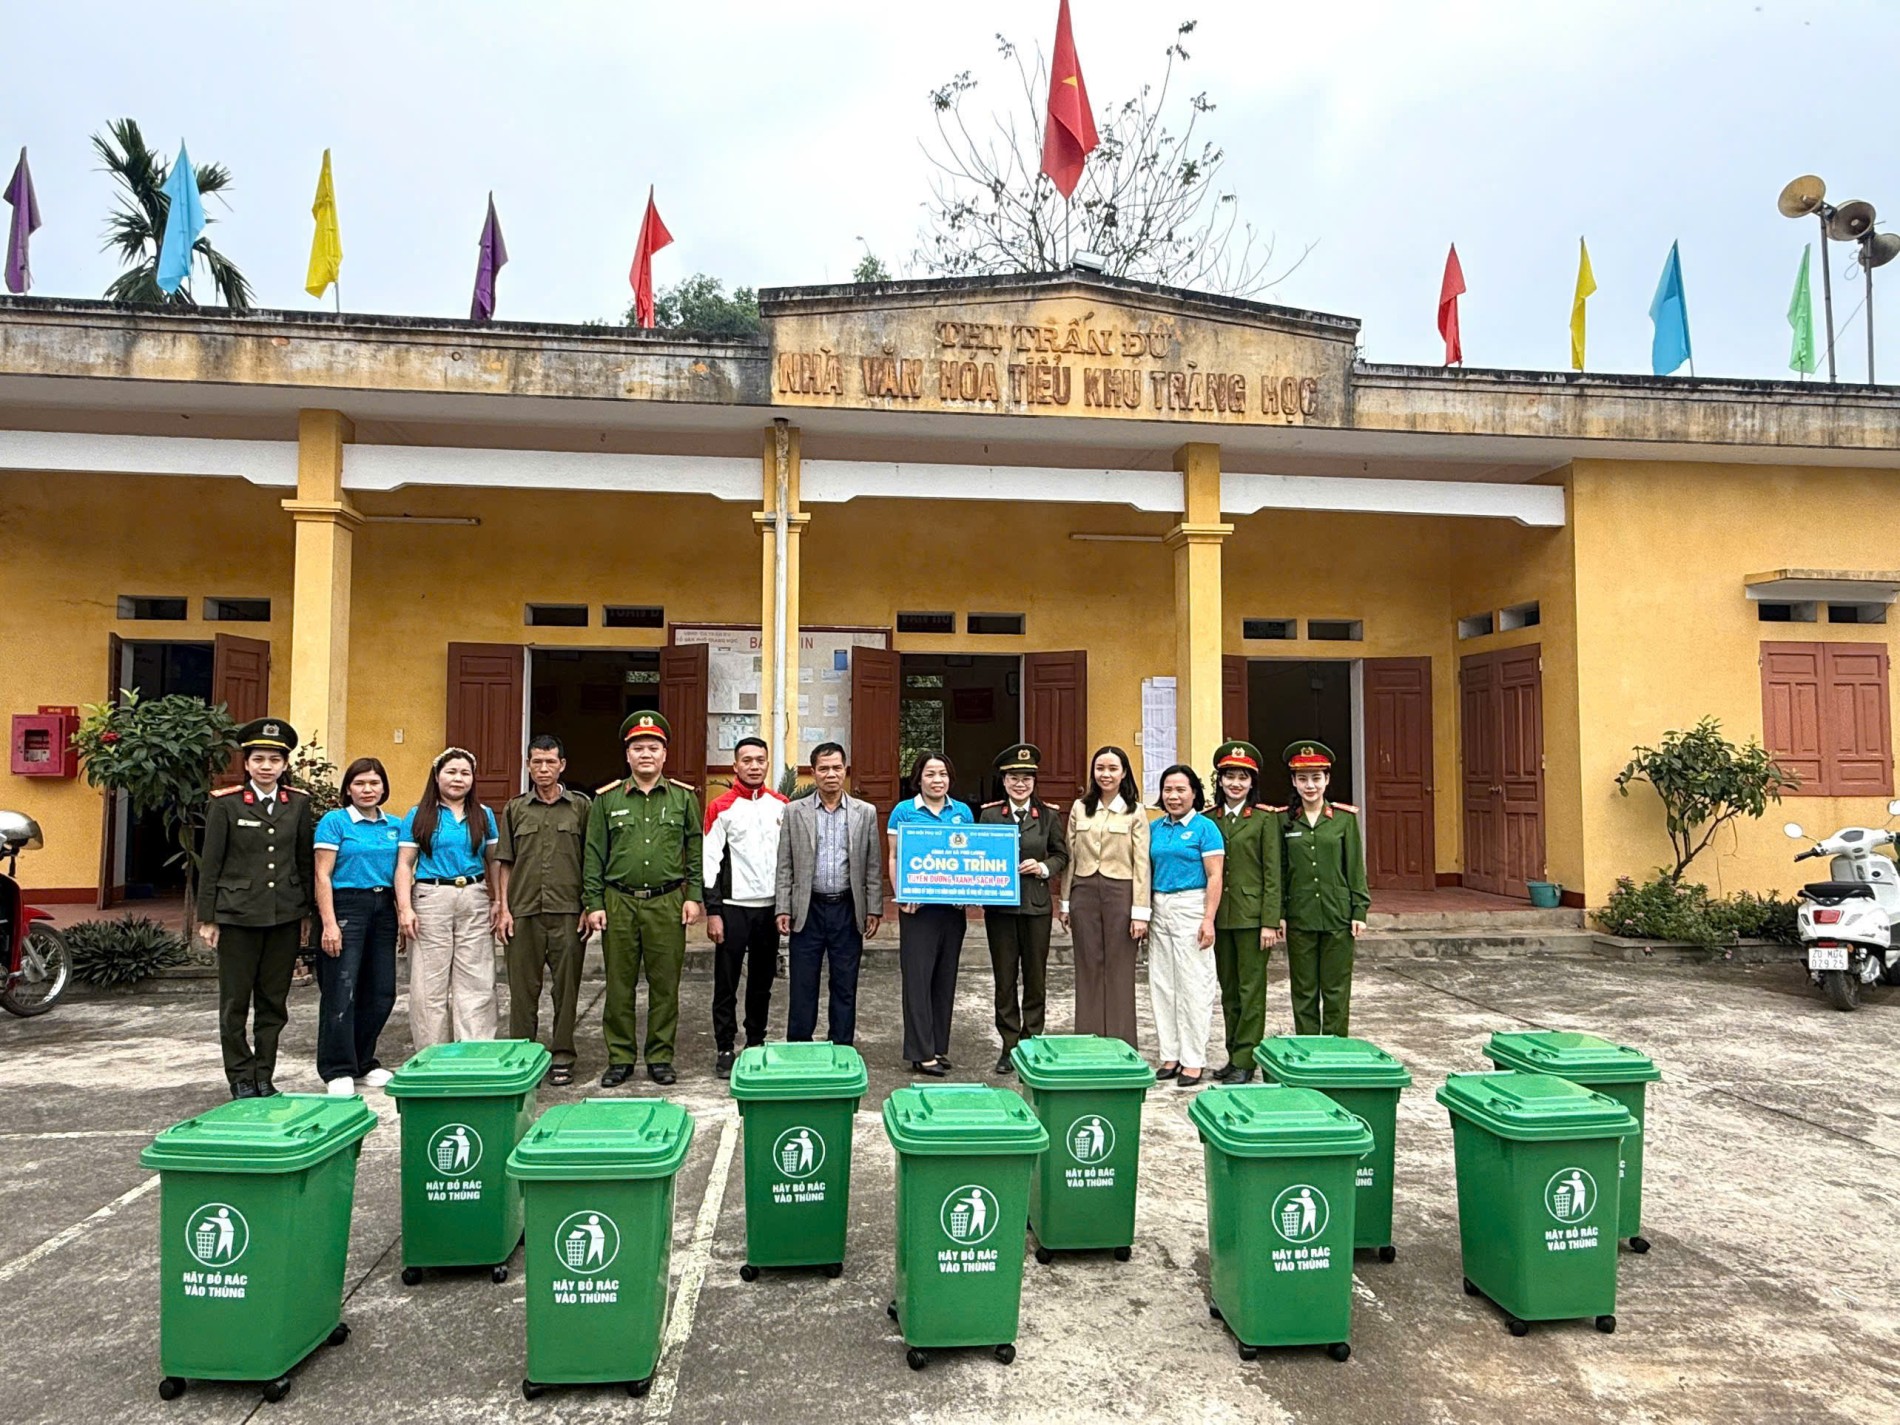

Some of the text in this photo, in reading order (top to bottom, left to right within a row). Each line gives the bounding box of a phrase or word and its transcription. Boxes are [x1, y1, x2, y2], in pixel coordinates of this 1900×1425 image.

[1012, 311, 1112, 356] TRẤN
[779, 348, 844, 395] NHÀ
[861, 343, 922, 400] VĂN
[939, 349, 999, 401] HÓA
[1008, 354, 1072, 405] TIỂU
[1084, 367, 1141, 409] KHU
[1261, 375, 1318, 424] HỌC
[910, 854, 1007, 872] CÔNG TRÌNH
[1066, 1167, 1114, 1177] HÃY BỎ RÁC
[427, 1179, 481, 1190] HÃY BỎ RÁC
[773, 1181, 825, 1192] HÃY BỎ RÁC
[1067, 1177, 1113, 1187] VÀO THÙNG
[428, 1190, 480, 1200] VÀO THÙNG
[775, 1191, 824, 1202] VÀO THÙNG
[1545, 1226, 1598, 1240] HÃY BỎ RÁC
[1547, 1238, 1597, 1251] VÀO THÙNG
[938, 1248, 997, 1260] HÃY BỎ RÁC
[1272, 1246, 1330, 1260] HÃY BỎ RÁC
[940, 1260, 995, 1273] VÀO THÙNG
[1275, 1258, 1329, 1271] VÀO THÙNG
[183, 1271, 247, 1285] HÃY BỎ RÁC
[553, 1278, 619, 1290] HÃY BỎ RÁC
[185, 1284, 245, 1298] VÀO THÙNG
[555, 1291, 617, 1303] VÀO THÙNG
